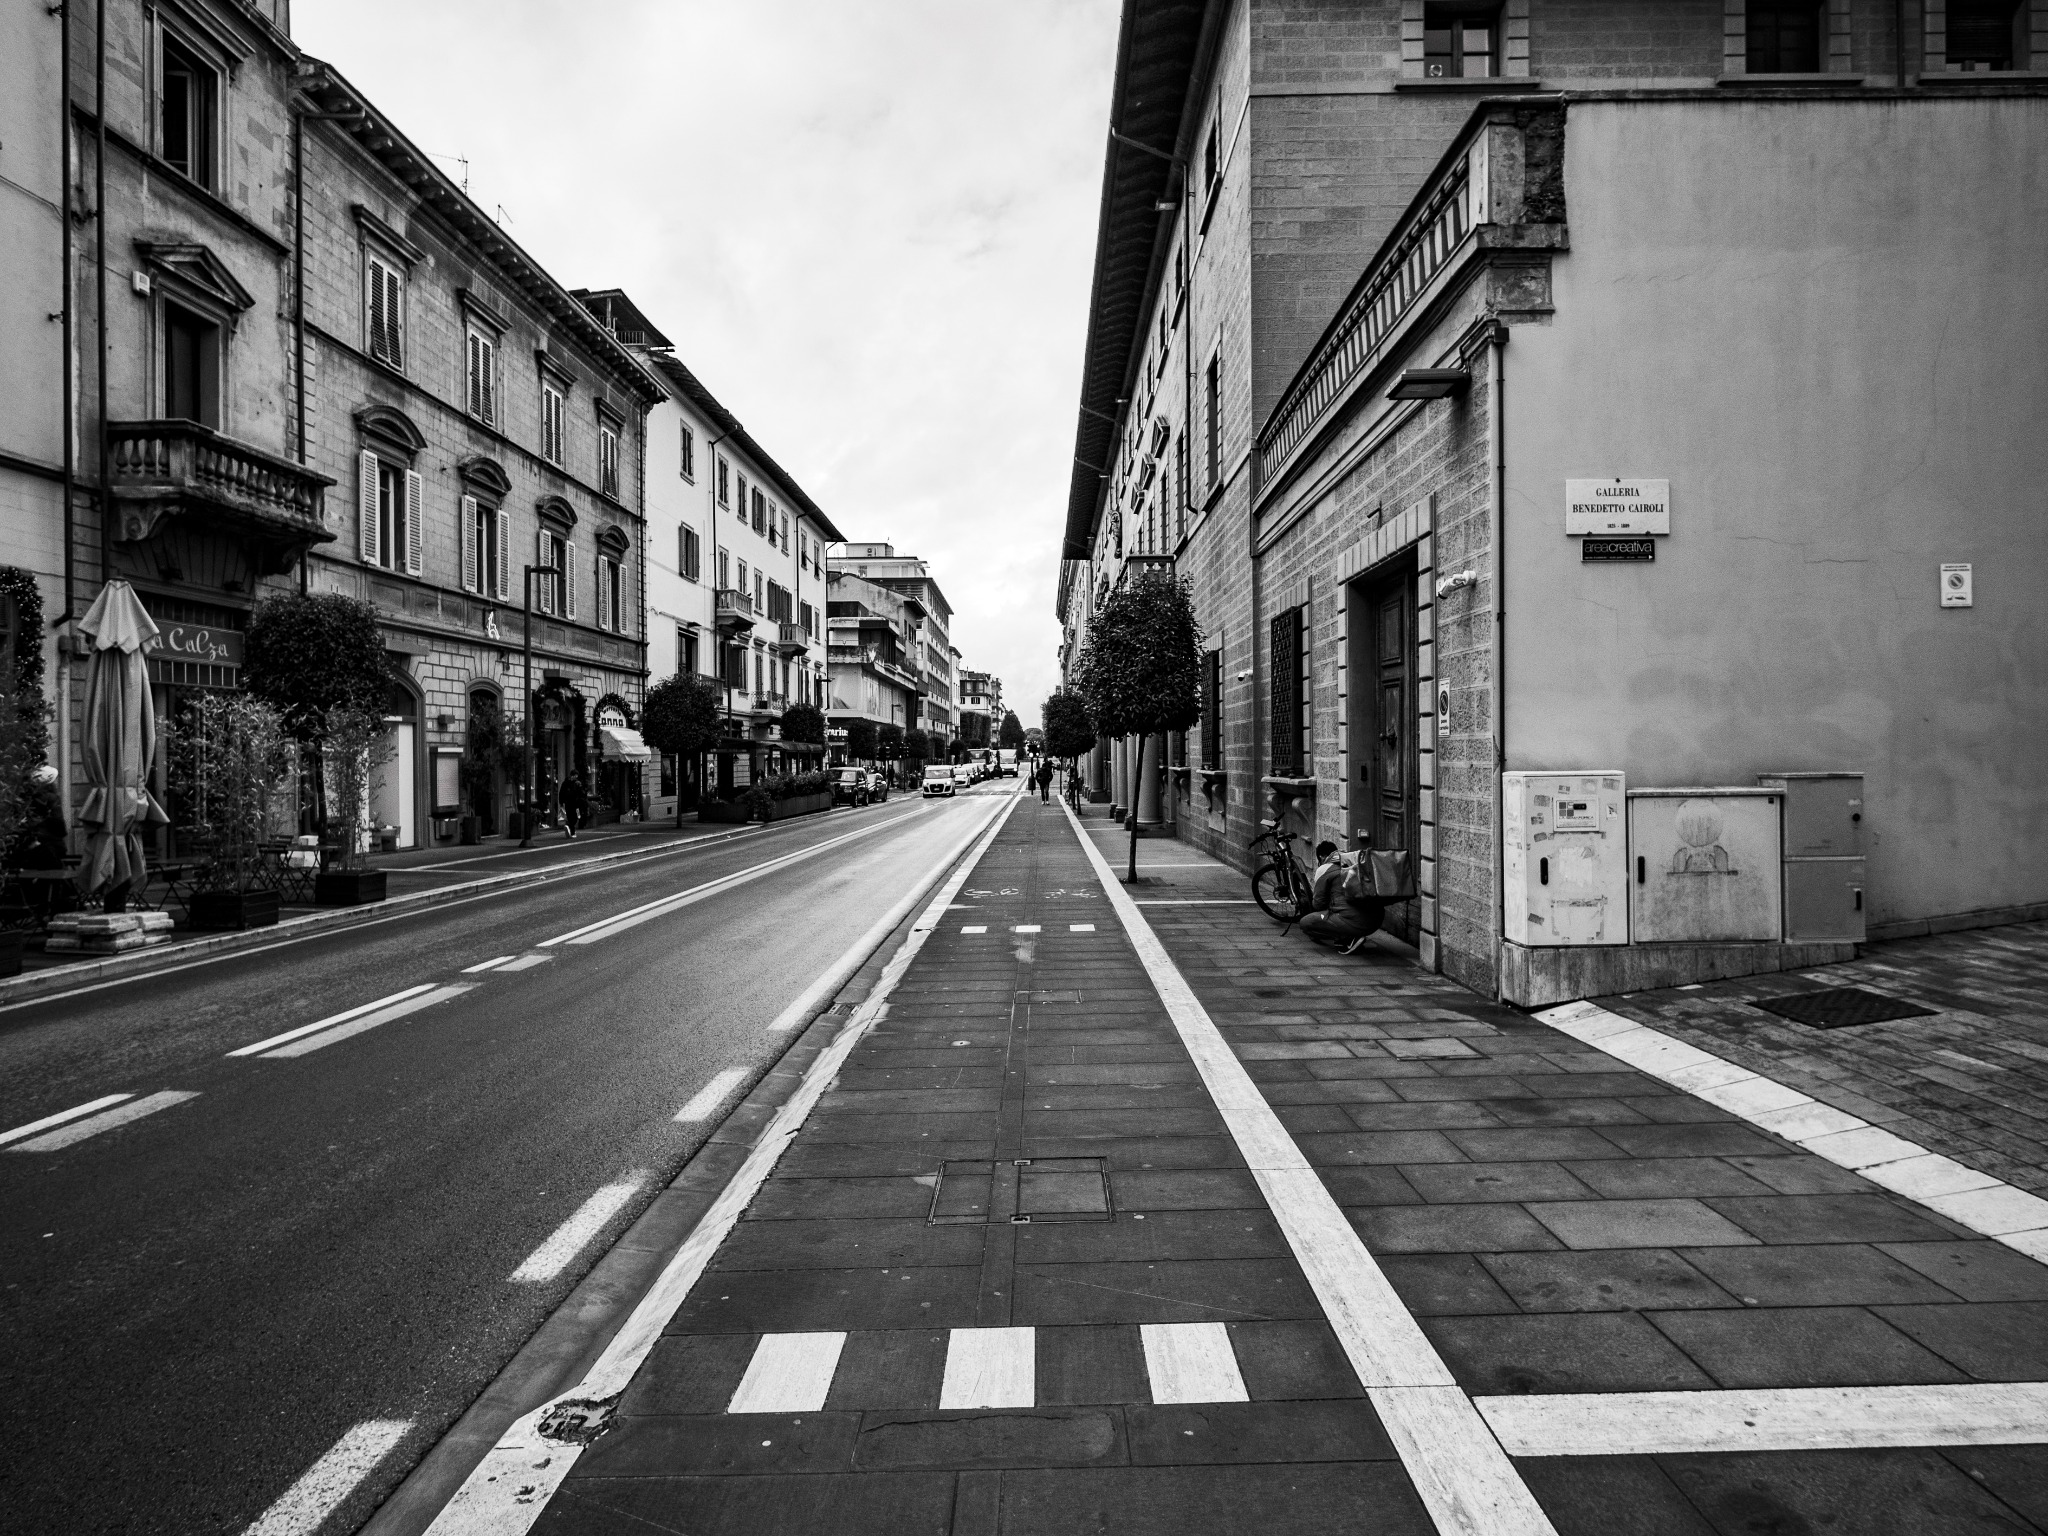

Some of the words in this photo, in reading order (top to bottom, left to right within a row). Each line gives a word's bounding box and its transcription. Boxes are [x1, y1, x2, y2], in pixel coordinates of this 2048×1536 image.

[1596, 488, 1640, 496] GALLERIA
[1573, 504, 1625, 512] BENEDETTO
[1629, 504, 1664, 512] CAIROLI
[1584, 541, 1652, 553] areacreativa
[151, 635, 164, 649] a
[169, 627, 229, 661] Calza
